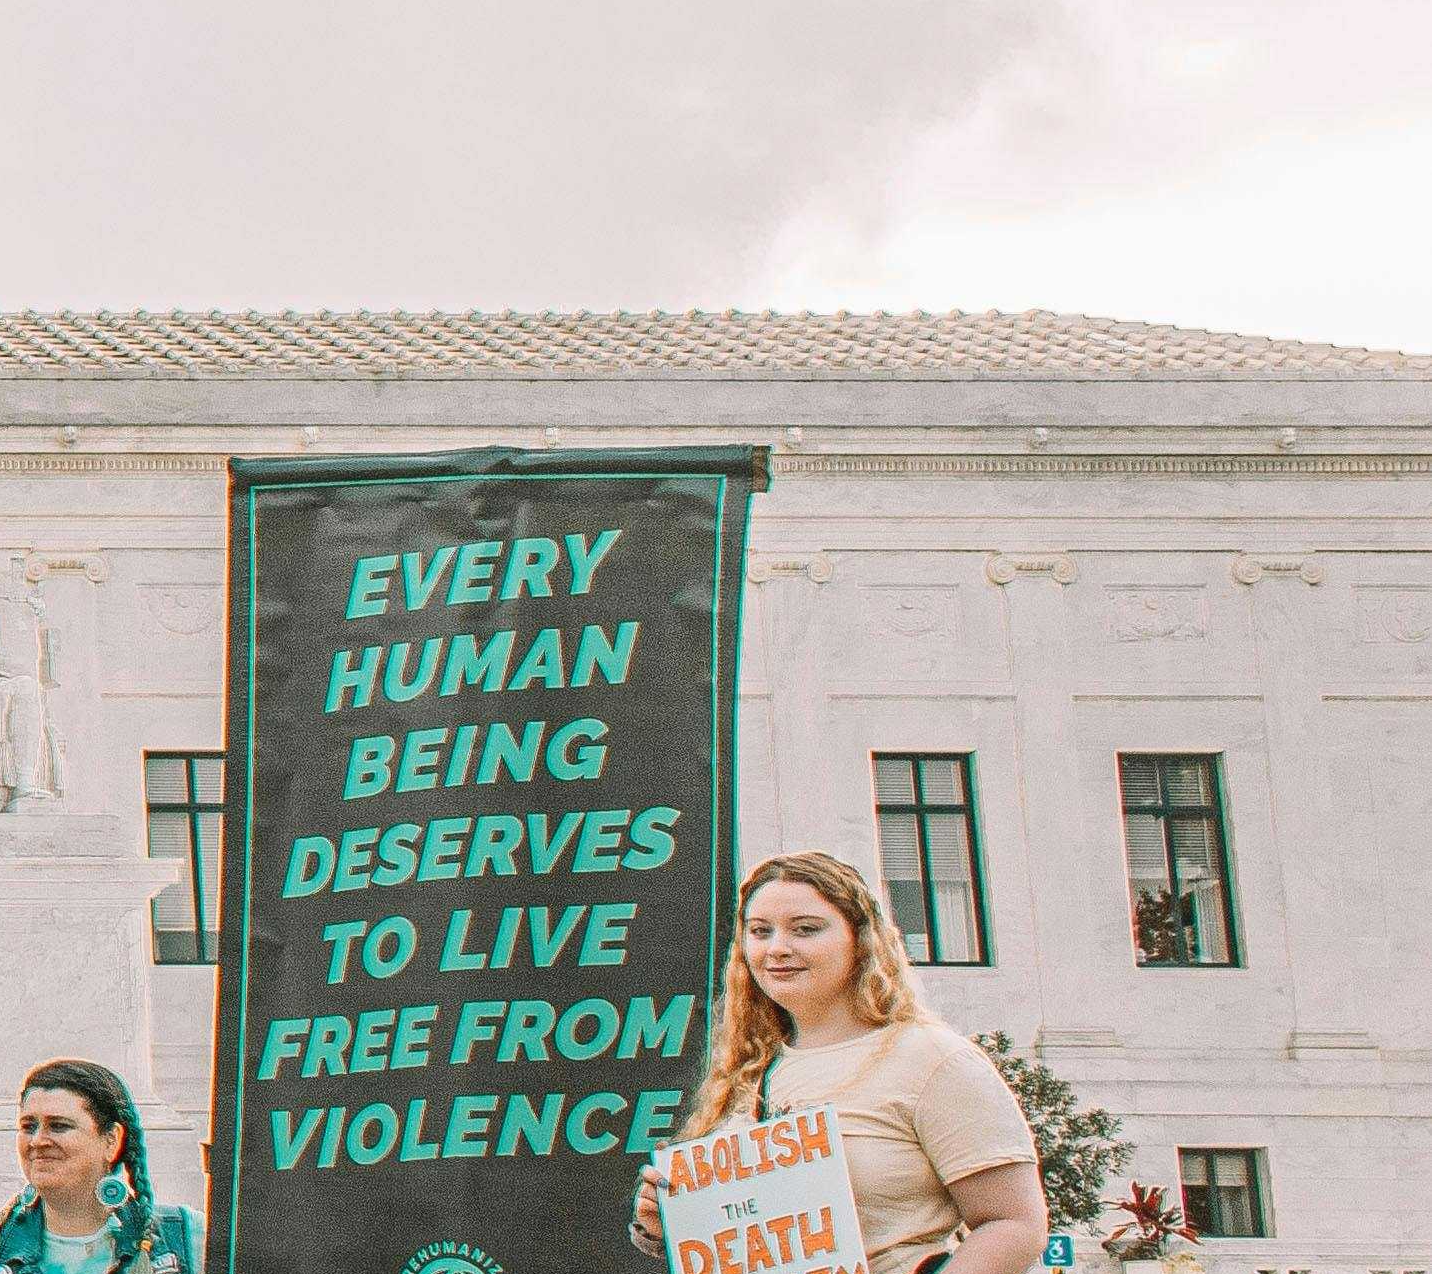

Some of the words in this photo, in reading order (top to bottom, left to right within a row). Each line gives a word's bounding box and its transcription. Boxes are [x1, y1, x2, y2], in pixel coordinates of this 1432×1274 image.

[345, 529, 623, 620] EVERY
[325, 621, 638, 713] HUMAN
[343, 718, 609, 800] BEING
[282, 806, 681, 899] DESERVES
[322, 916, 417, 985] TO
[438, 902, 637, 972] LIVE
[257, 1003, 438, 1080] FREE
[449, 993, 695, 1065] FROM
[271, 1089, 684, 1171] VIOLENCE
[669, 1110, 832, 1197] ABOLISH
[721, 1198, 758, 1220] THE
